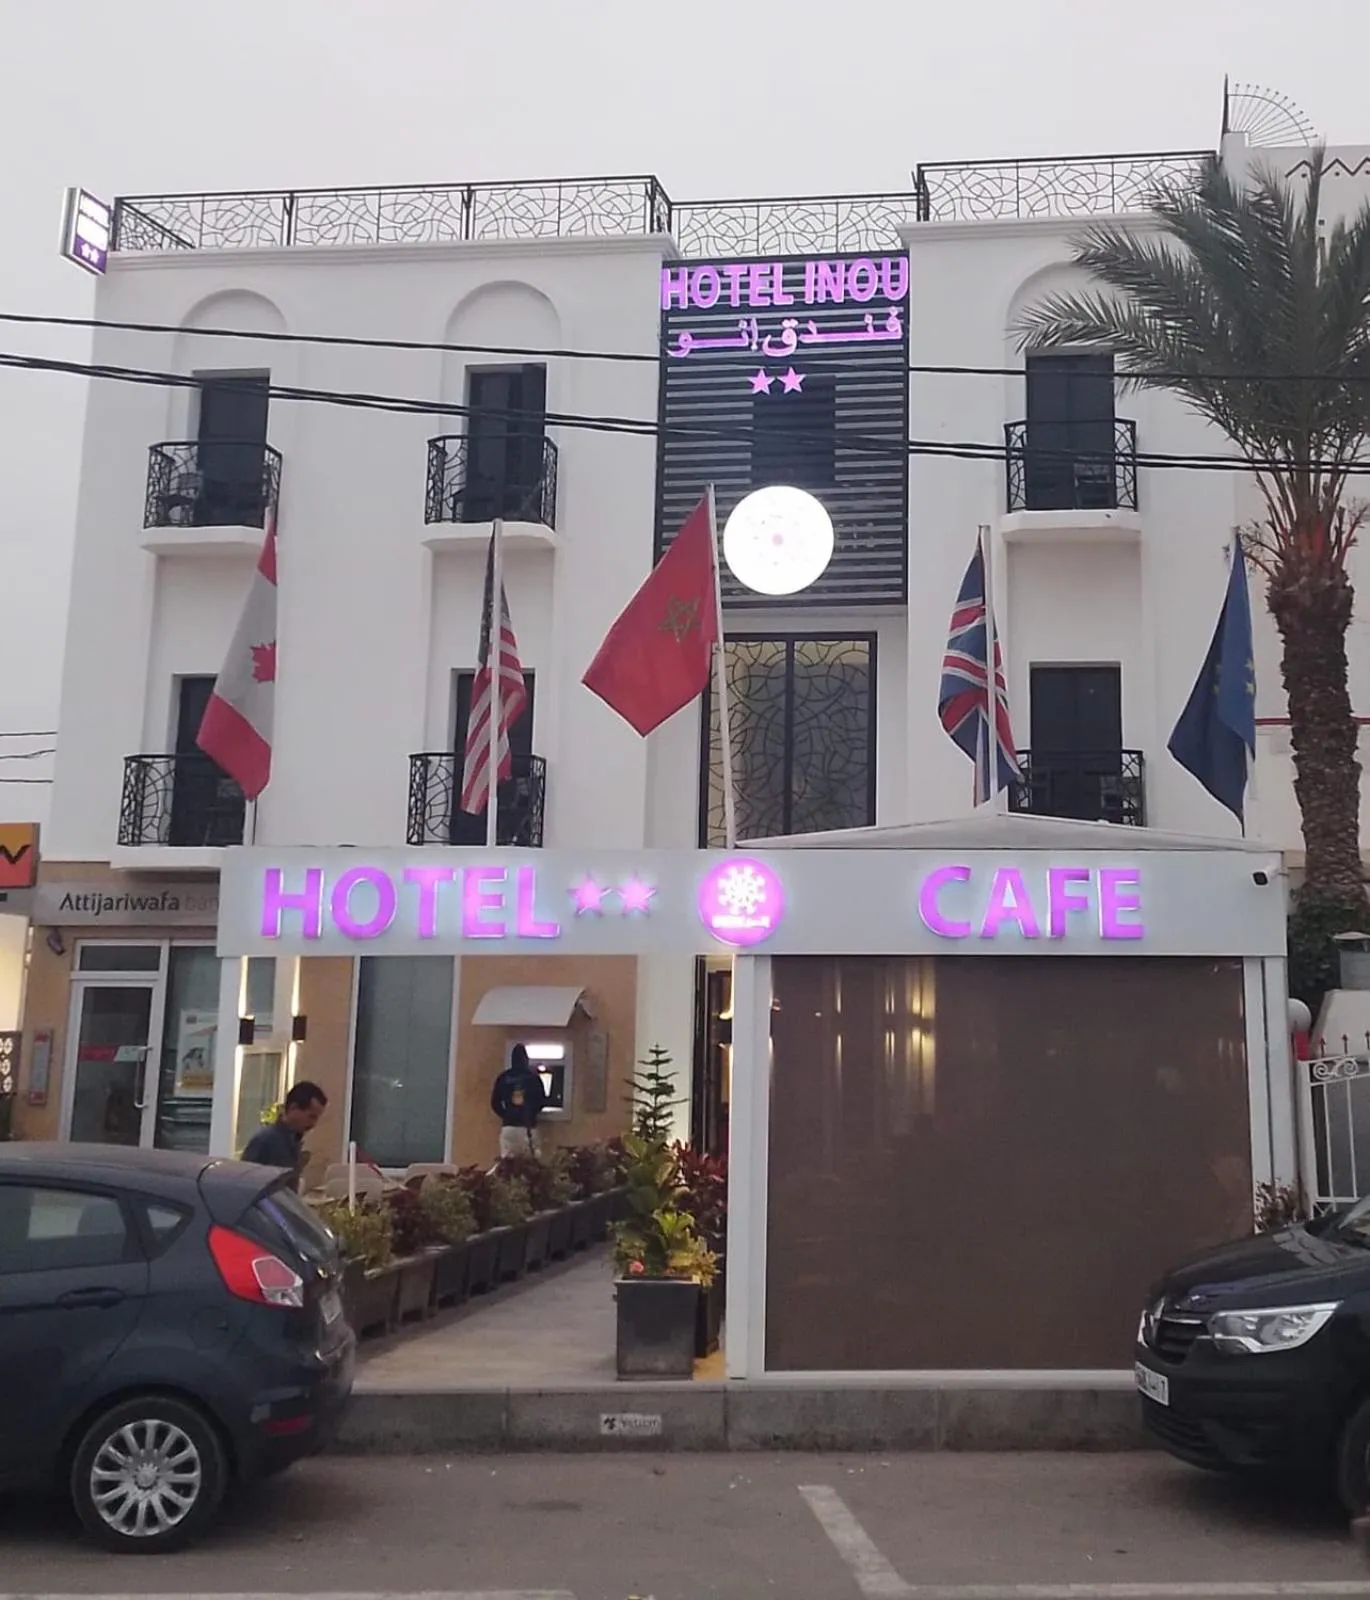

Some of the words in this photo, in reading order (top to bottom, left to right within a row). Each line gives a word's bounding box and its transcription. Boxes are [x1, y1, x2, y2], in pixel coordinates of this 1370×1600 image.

[661, 263, 795, 310] HOTEL
[804, 257, 909, 304] INOU
[762, 306, 903, 357] فندق
[59, 892, 179, 916] Attijariwafa
[260, 866, 562, 940] HOTEL
[918, 865, 1144, 939] CAFE
